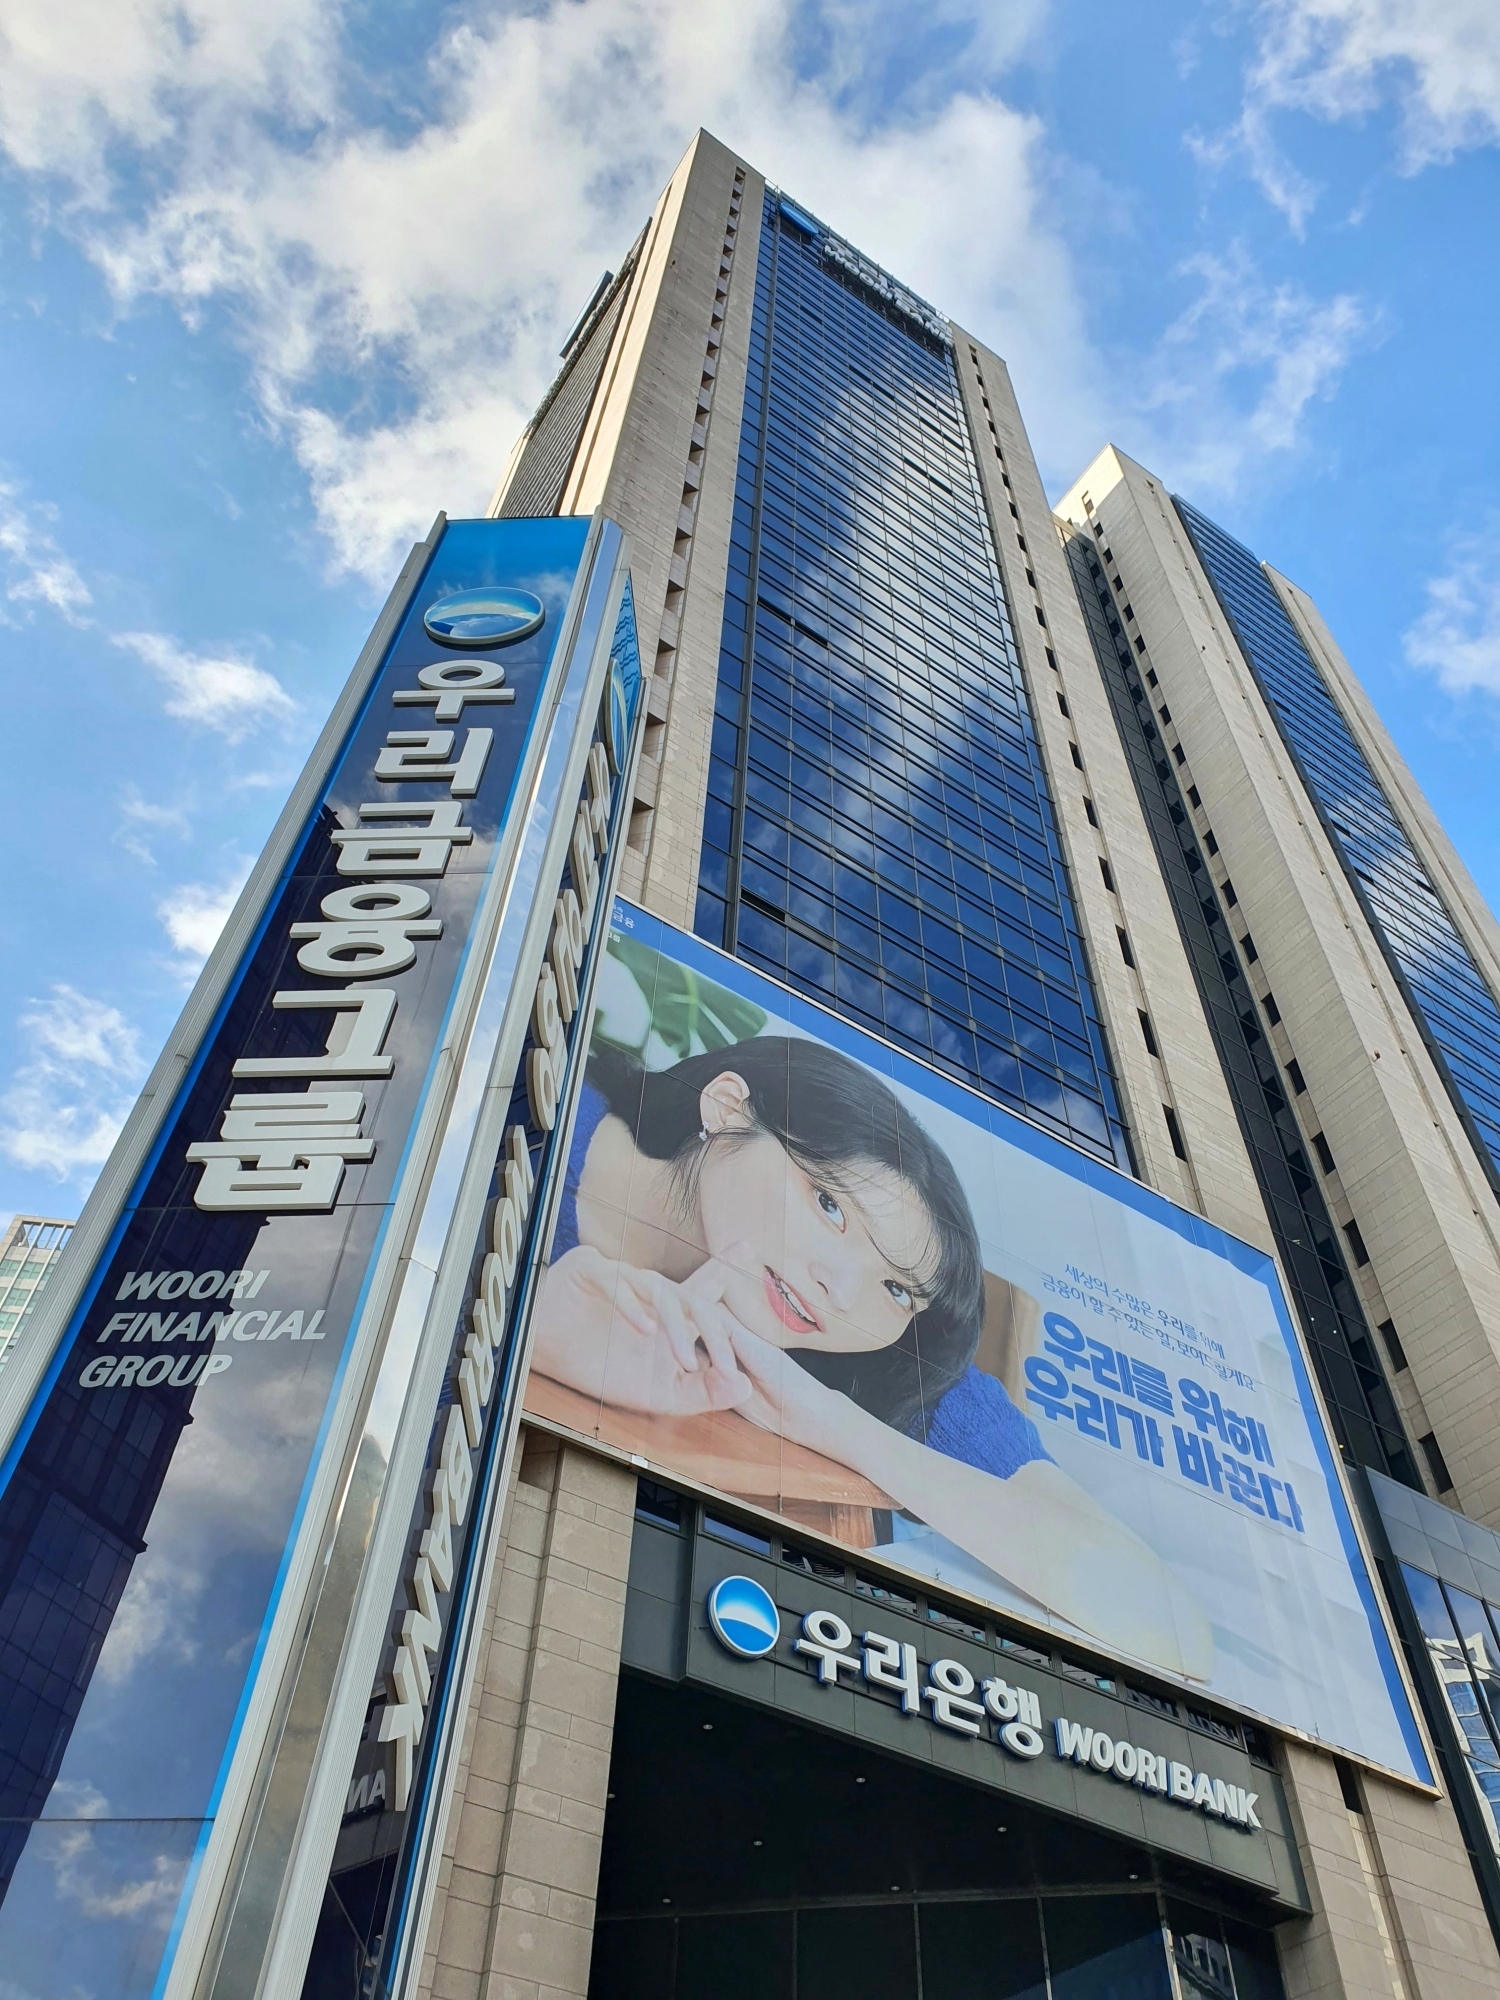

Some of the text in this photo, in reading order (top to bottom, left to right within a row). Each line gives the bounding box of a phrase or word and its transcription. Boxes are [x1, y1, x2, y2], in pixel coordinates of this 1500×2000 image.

[824, 244, 955, 348] WOORI BANK
[186, 659, 516, 1212] 우리금융그룹
[96, 1309, 326, 1343] FINANCIAL
[115, 1269, 271, 1301] WOORI
[1041, 1271, 1087, 1308] 금융이
[1089, 1296, 1105, 1317] 할
[1107, 1306, 1123, 1323] 수
[1124, 1312, 1155, 1341] 있는
[1064, 1263, 1226, 1360] 세상의 수많은 우리를 위해
[78, 1354, 233, 1388] GROUP
[1043, 1311, 1276, 1468] 우리를 위해
[378, 1124, 535, 1812] WOORI BANK
[1024, 1355, 1306, 1534] 우리가 바꾼다
[794, 1610, 1044, 1761] 우리은행
[1055, 1717, 1263, 1831] WOORI BANK
